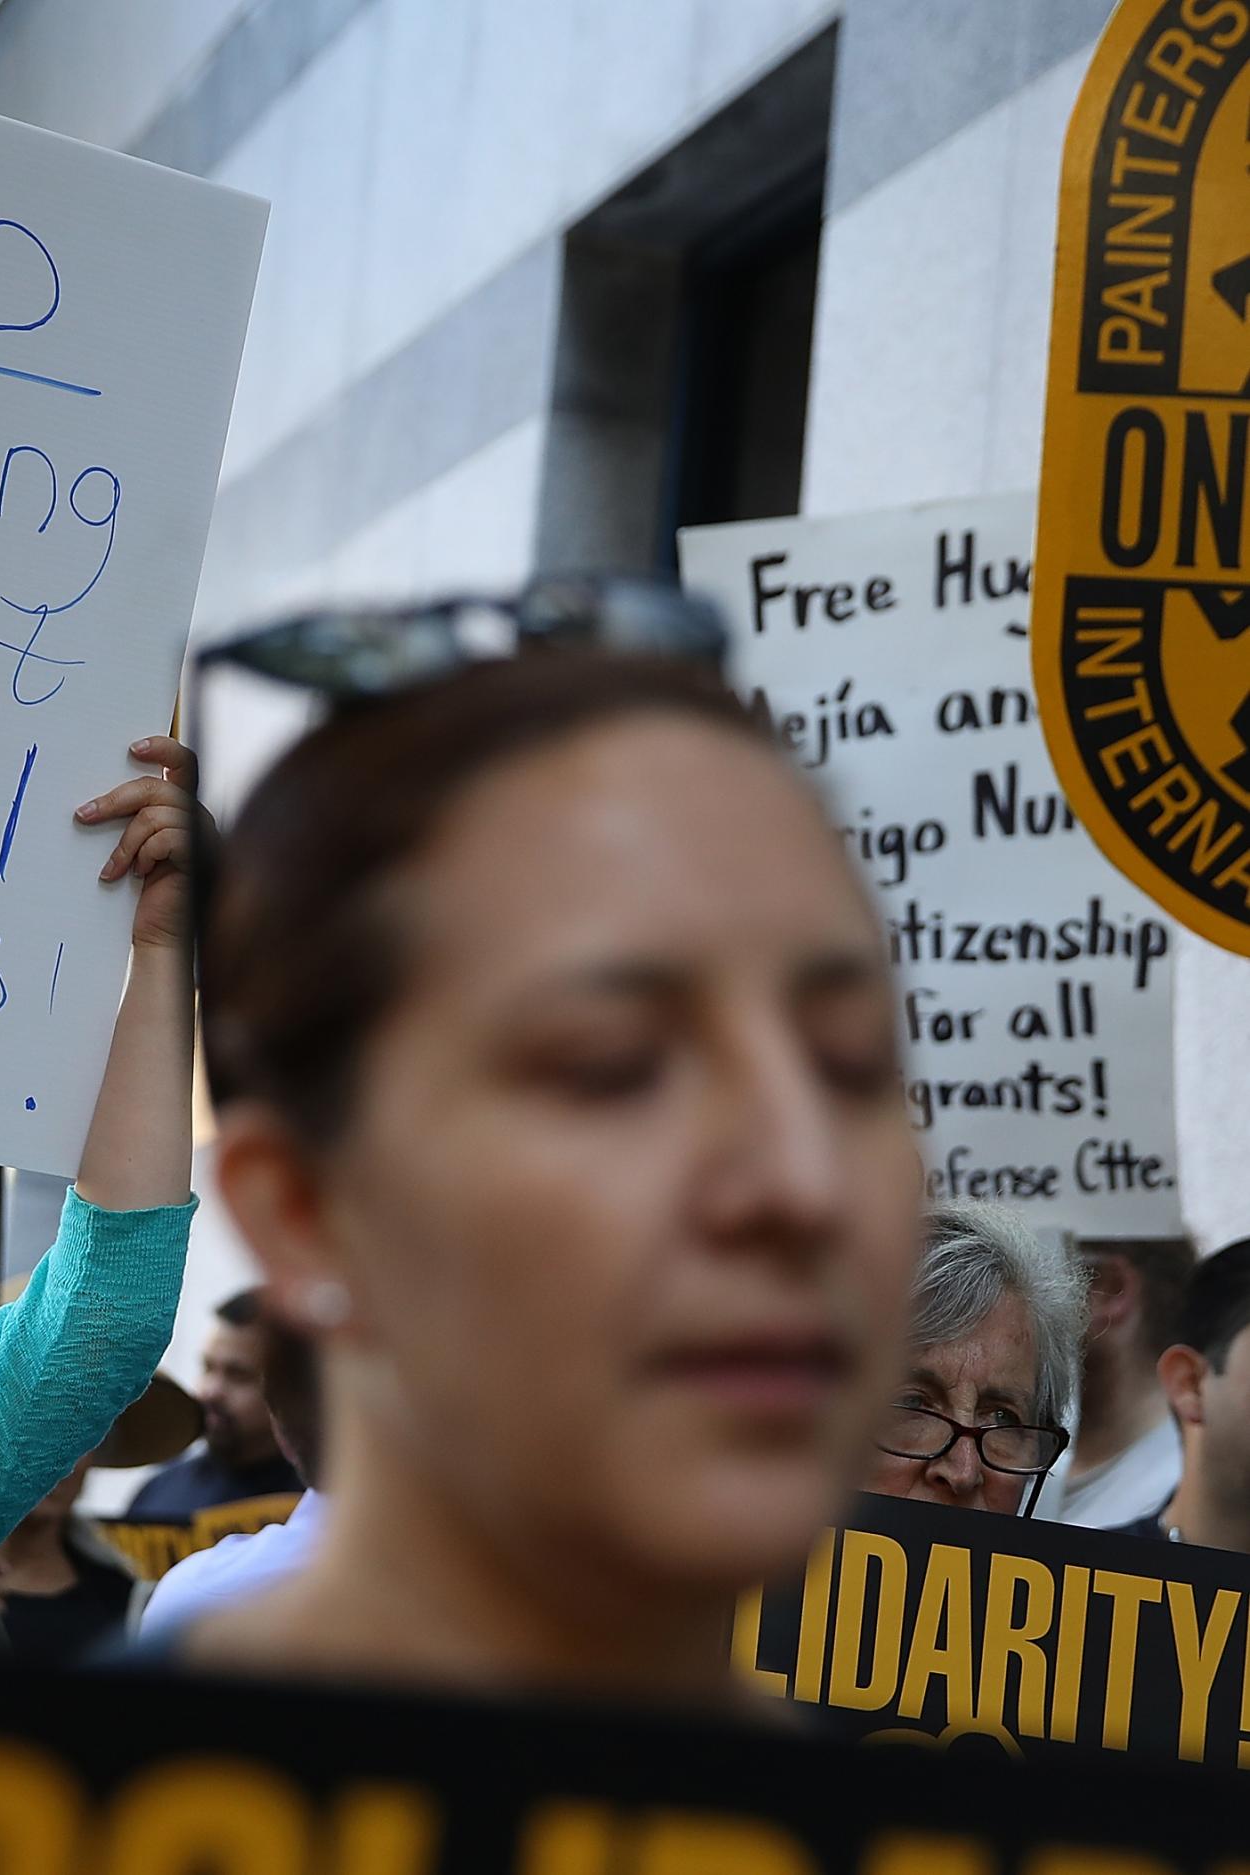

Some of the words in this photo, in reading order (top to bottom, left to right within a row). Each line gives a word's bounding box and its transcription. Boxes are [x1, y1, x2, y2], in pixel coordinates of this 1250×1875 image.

[751, 553, 898, 632] Free
[936, 686, 1035, 733] an
[905, 987, 984, 1041] for
[1009, 978, 1096, 1040] all
[1075, 1137, 1177, 1193] Ctte.
